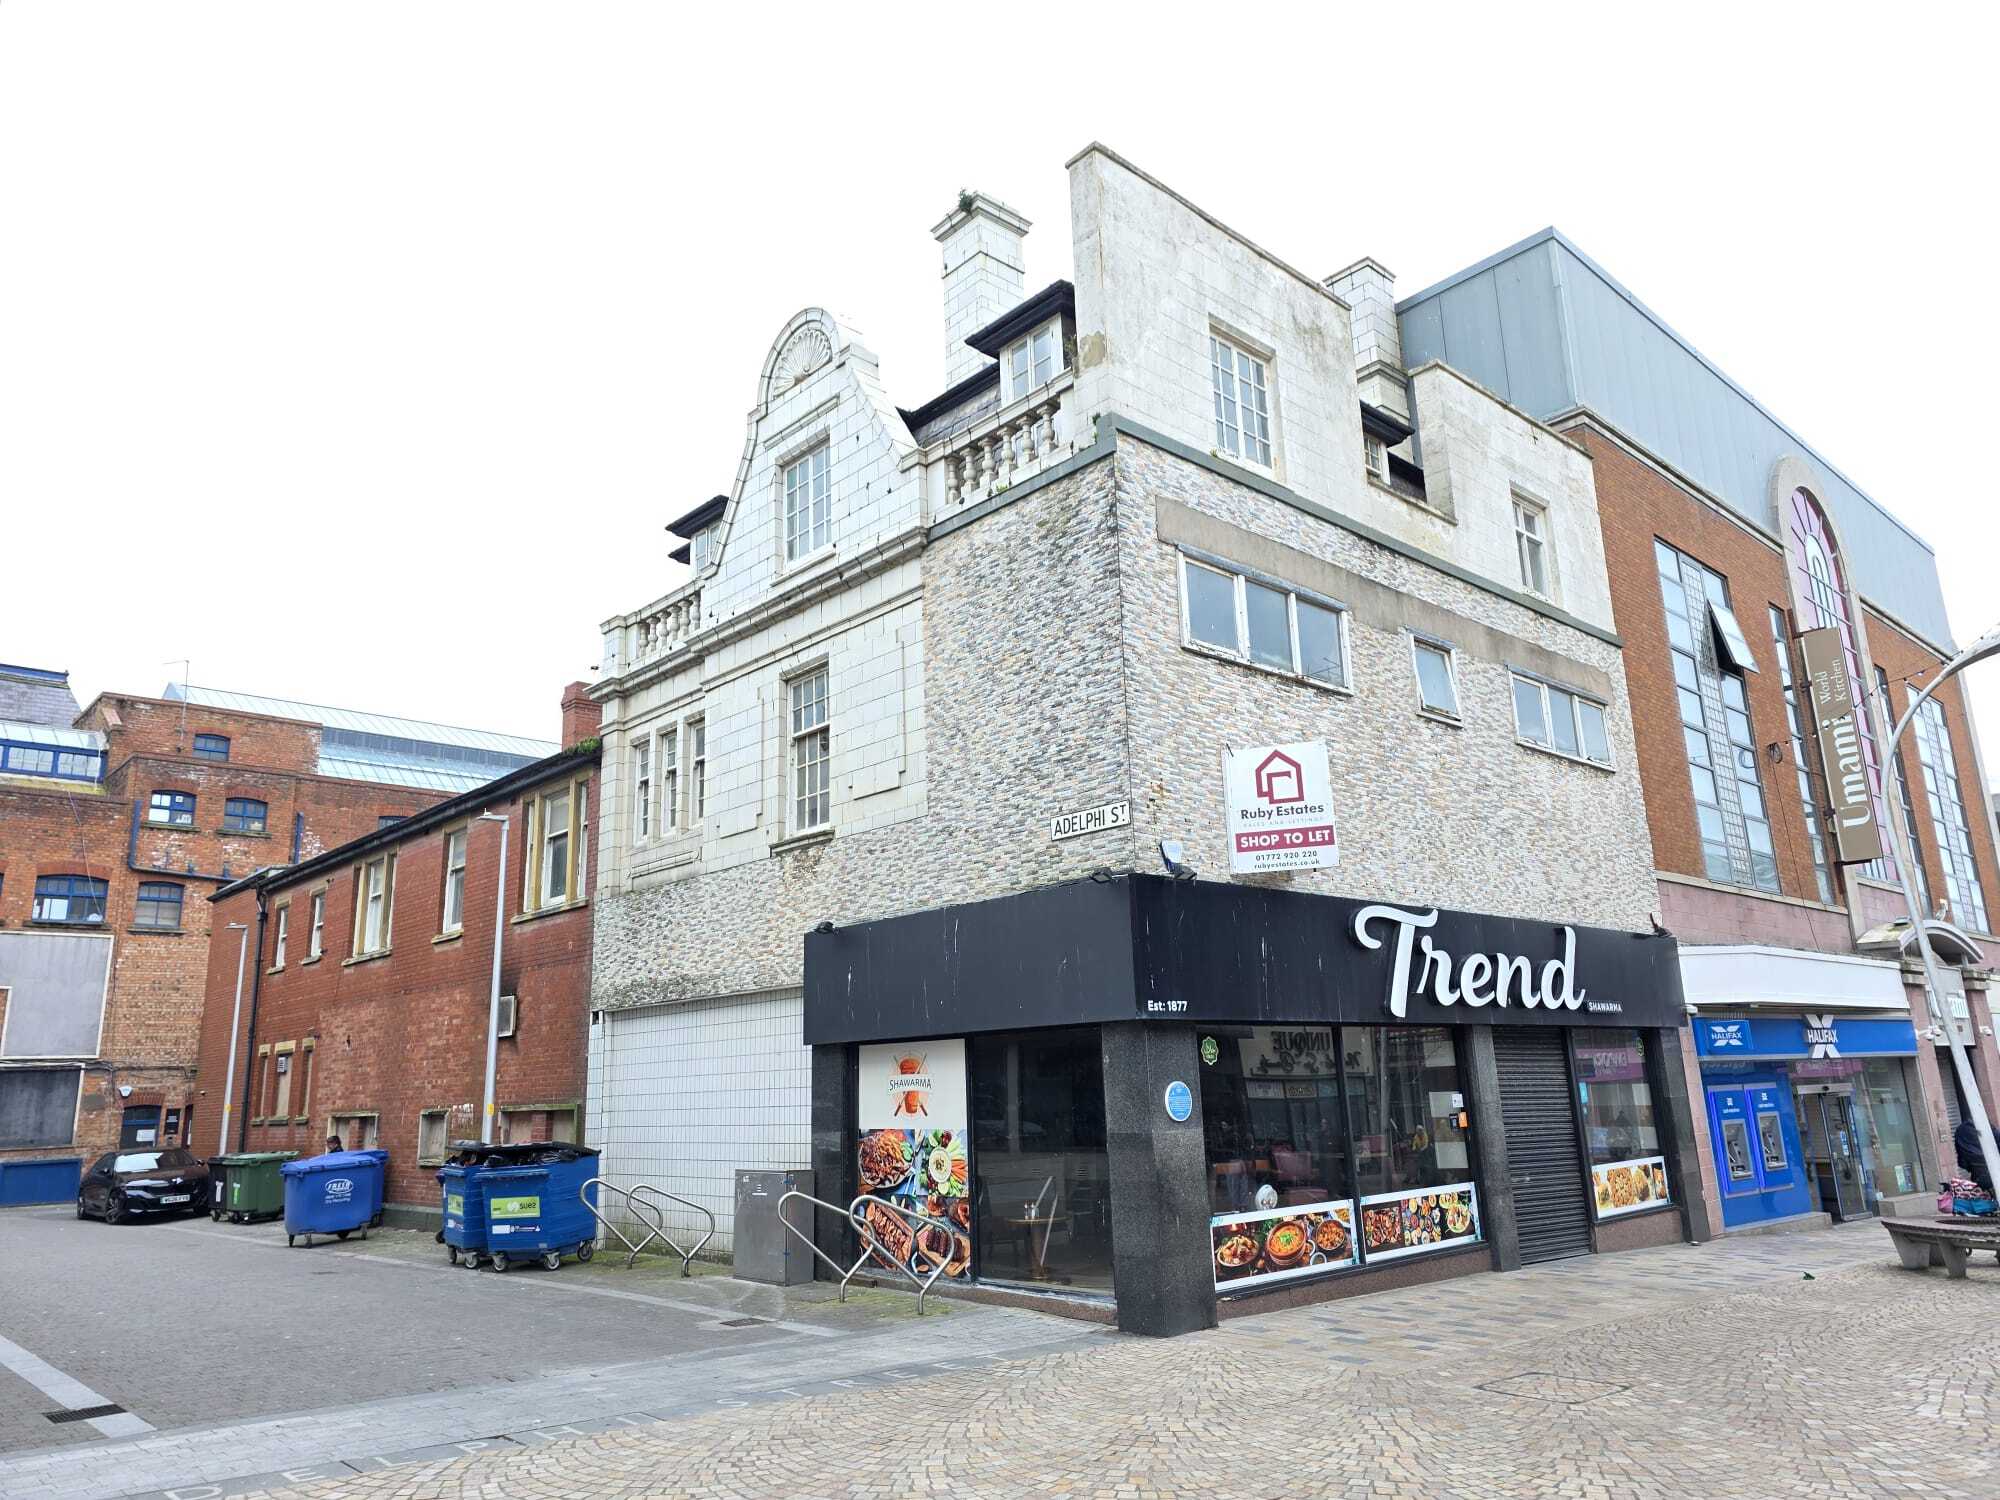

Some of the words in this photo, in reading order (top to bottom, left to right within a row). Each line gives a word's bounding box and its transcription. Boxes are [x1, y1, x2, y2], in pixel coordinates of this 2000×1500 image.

[1815, 671, 1831, 704] World
[1831, 659, 1847, 703] Kitchen
[1822, 714, 1871, 828] Umami
[1240, 808, 1274, 820] Ruby
[1276, 804, 1325, 816] Estates
[1054, 809, 1105, 836] ADELPHI
[1240, 834, 1279, 848] SHOP
[1284, 832, 1303, 844] TO
[1308, 829, 1330, 843] LET
[1255, 853, 1281, 861] 01772
[1284, 851, 1299, 859] 920
[1254, 859, 1320, 870] rubyestates.co.uk
[1354, 905, 1586, 1018] Trend
[1147, 1000, 1166, 1011] Est:
[1167, 1000, 1188, 1011] 1877
[1588, 1001, 1623, 1012] SHAWARMA
[1711, 1031, 1742, 1040] HALIFAX
[1807, 1029, 1838, 1043] HALIFAX
[889, 1079, 932, 1091] SHAWARMA
